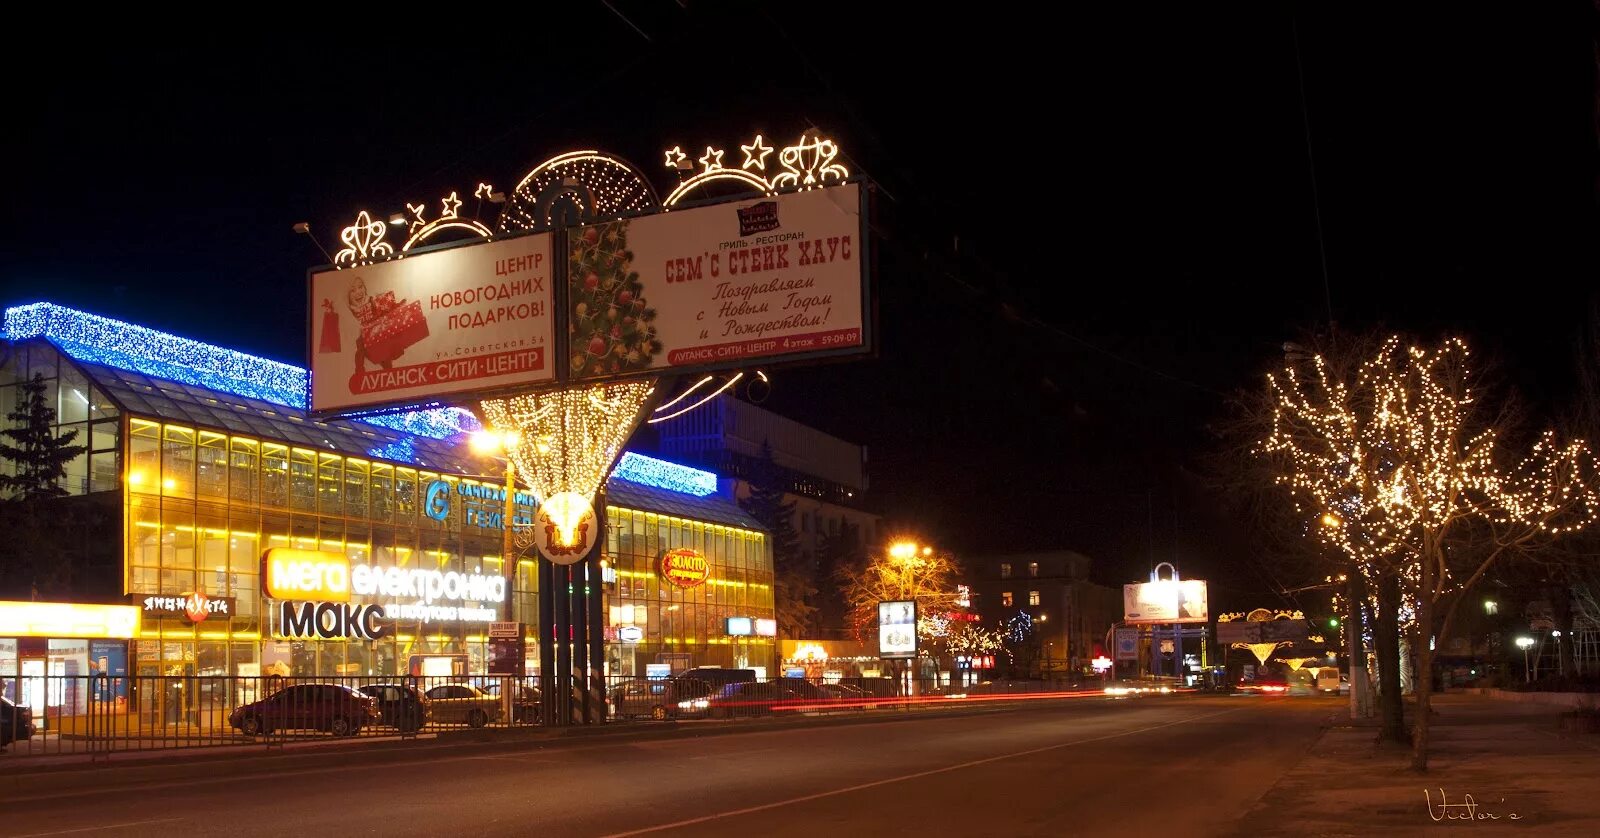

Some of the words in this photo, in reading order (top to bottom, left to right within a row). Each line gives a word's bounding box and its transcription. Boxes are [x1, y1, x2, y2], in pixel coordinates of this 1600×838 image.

[719, 238, 748, 250] ГРИЛЬ
[756, 231, 805, 245] РЕСТОРАН
[495, 252, 543, 277] ЦЕНТР
[665, 251, 719, 284] СЕМ'С
[729, 243, 789, 275] СТЕЙК
[798, 235, 851, 266] ХАУС
[430, 276, 544, 310] НОВОГОДНИХ
[712, 276, 815, 300] Поздравляем
[448, 300, 545, 330] ПОДАРКОВ!
[696, 311, 705, 321] с
[718, 301, 768, 319] Новым
[783, 292, 832, 312] Годом
[699, 329, 708, 339] и
[722, 307, 831, 337] Рождеством!
[674, 349, 713, 361] ЛУГАНСК
[718, 344, 742, 357] СИТИ
[746, 341, 777, 353] ЦЕНТР
[782, 338, 789, 348] 4
[791, 339, 815, 348] этаж
[360, 365, 427, 391] ЛУГАНСК
[435, 359, 478, 380] СИТИ
[486, 351, 539, 374] ЦЕНТР
[671, 554, 706, 571] ЗОЛОТО
